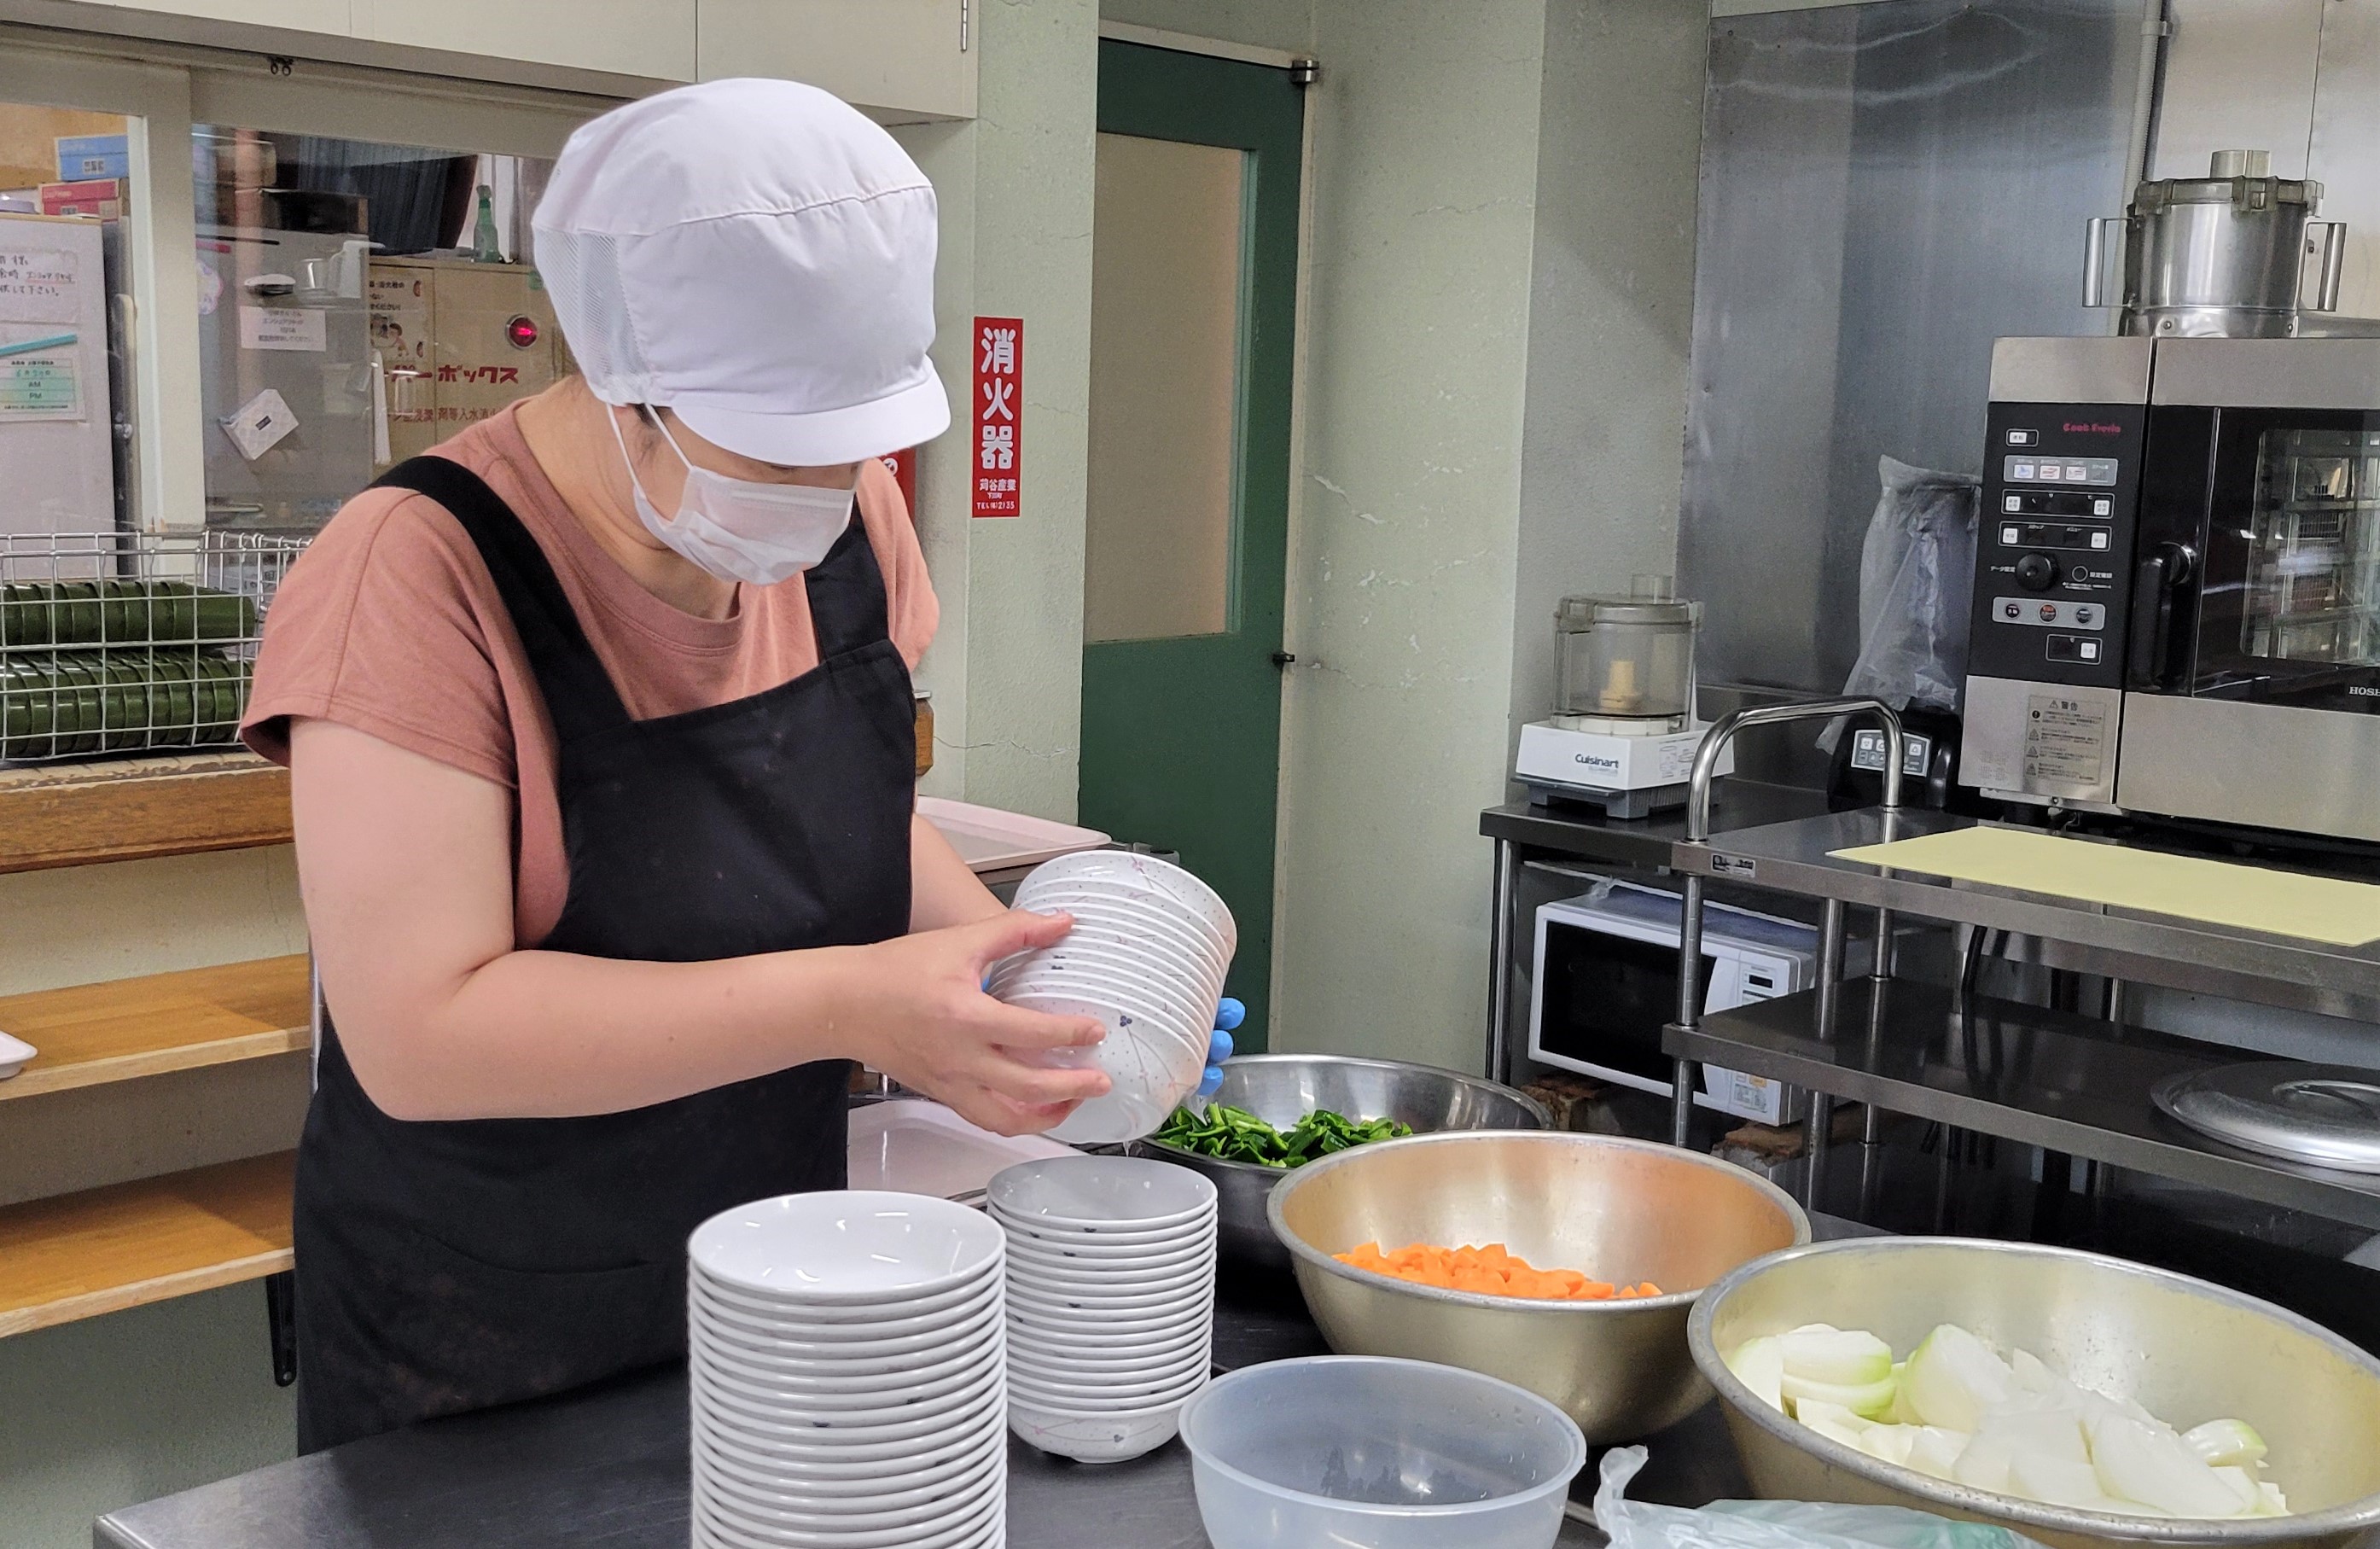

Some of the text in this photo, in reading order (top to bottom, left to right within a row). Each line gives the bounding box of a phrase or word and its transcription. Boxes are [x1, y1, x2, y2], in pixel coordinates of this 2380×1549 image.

[981, 327, 1016, 469] 消火器
[1574, 754, 1619, 769] Cuisinart
